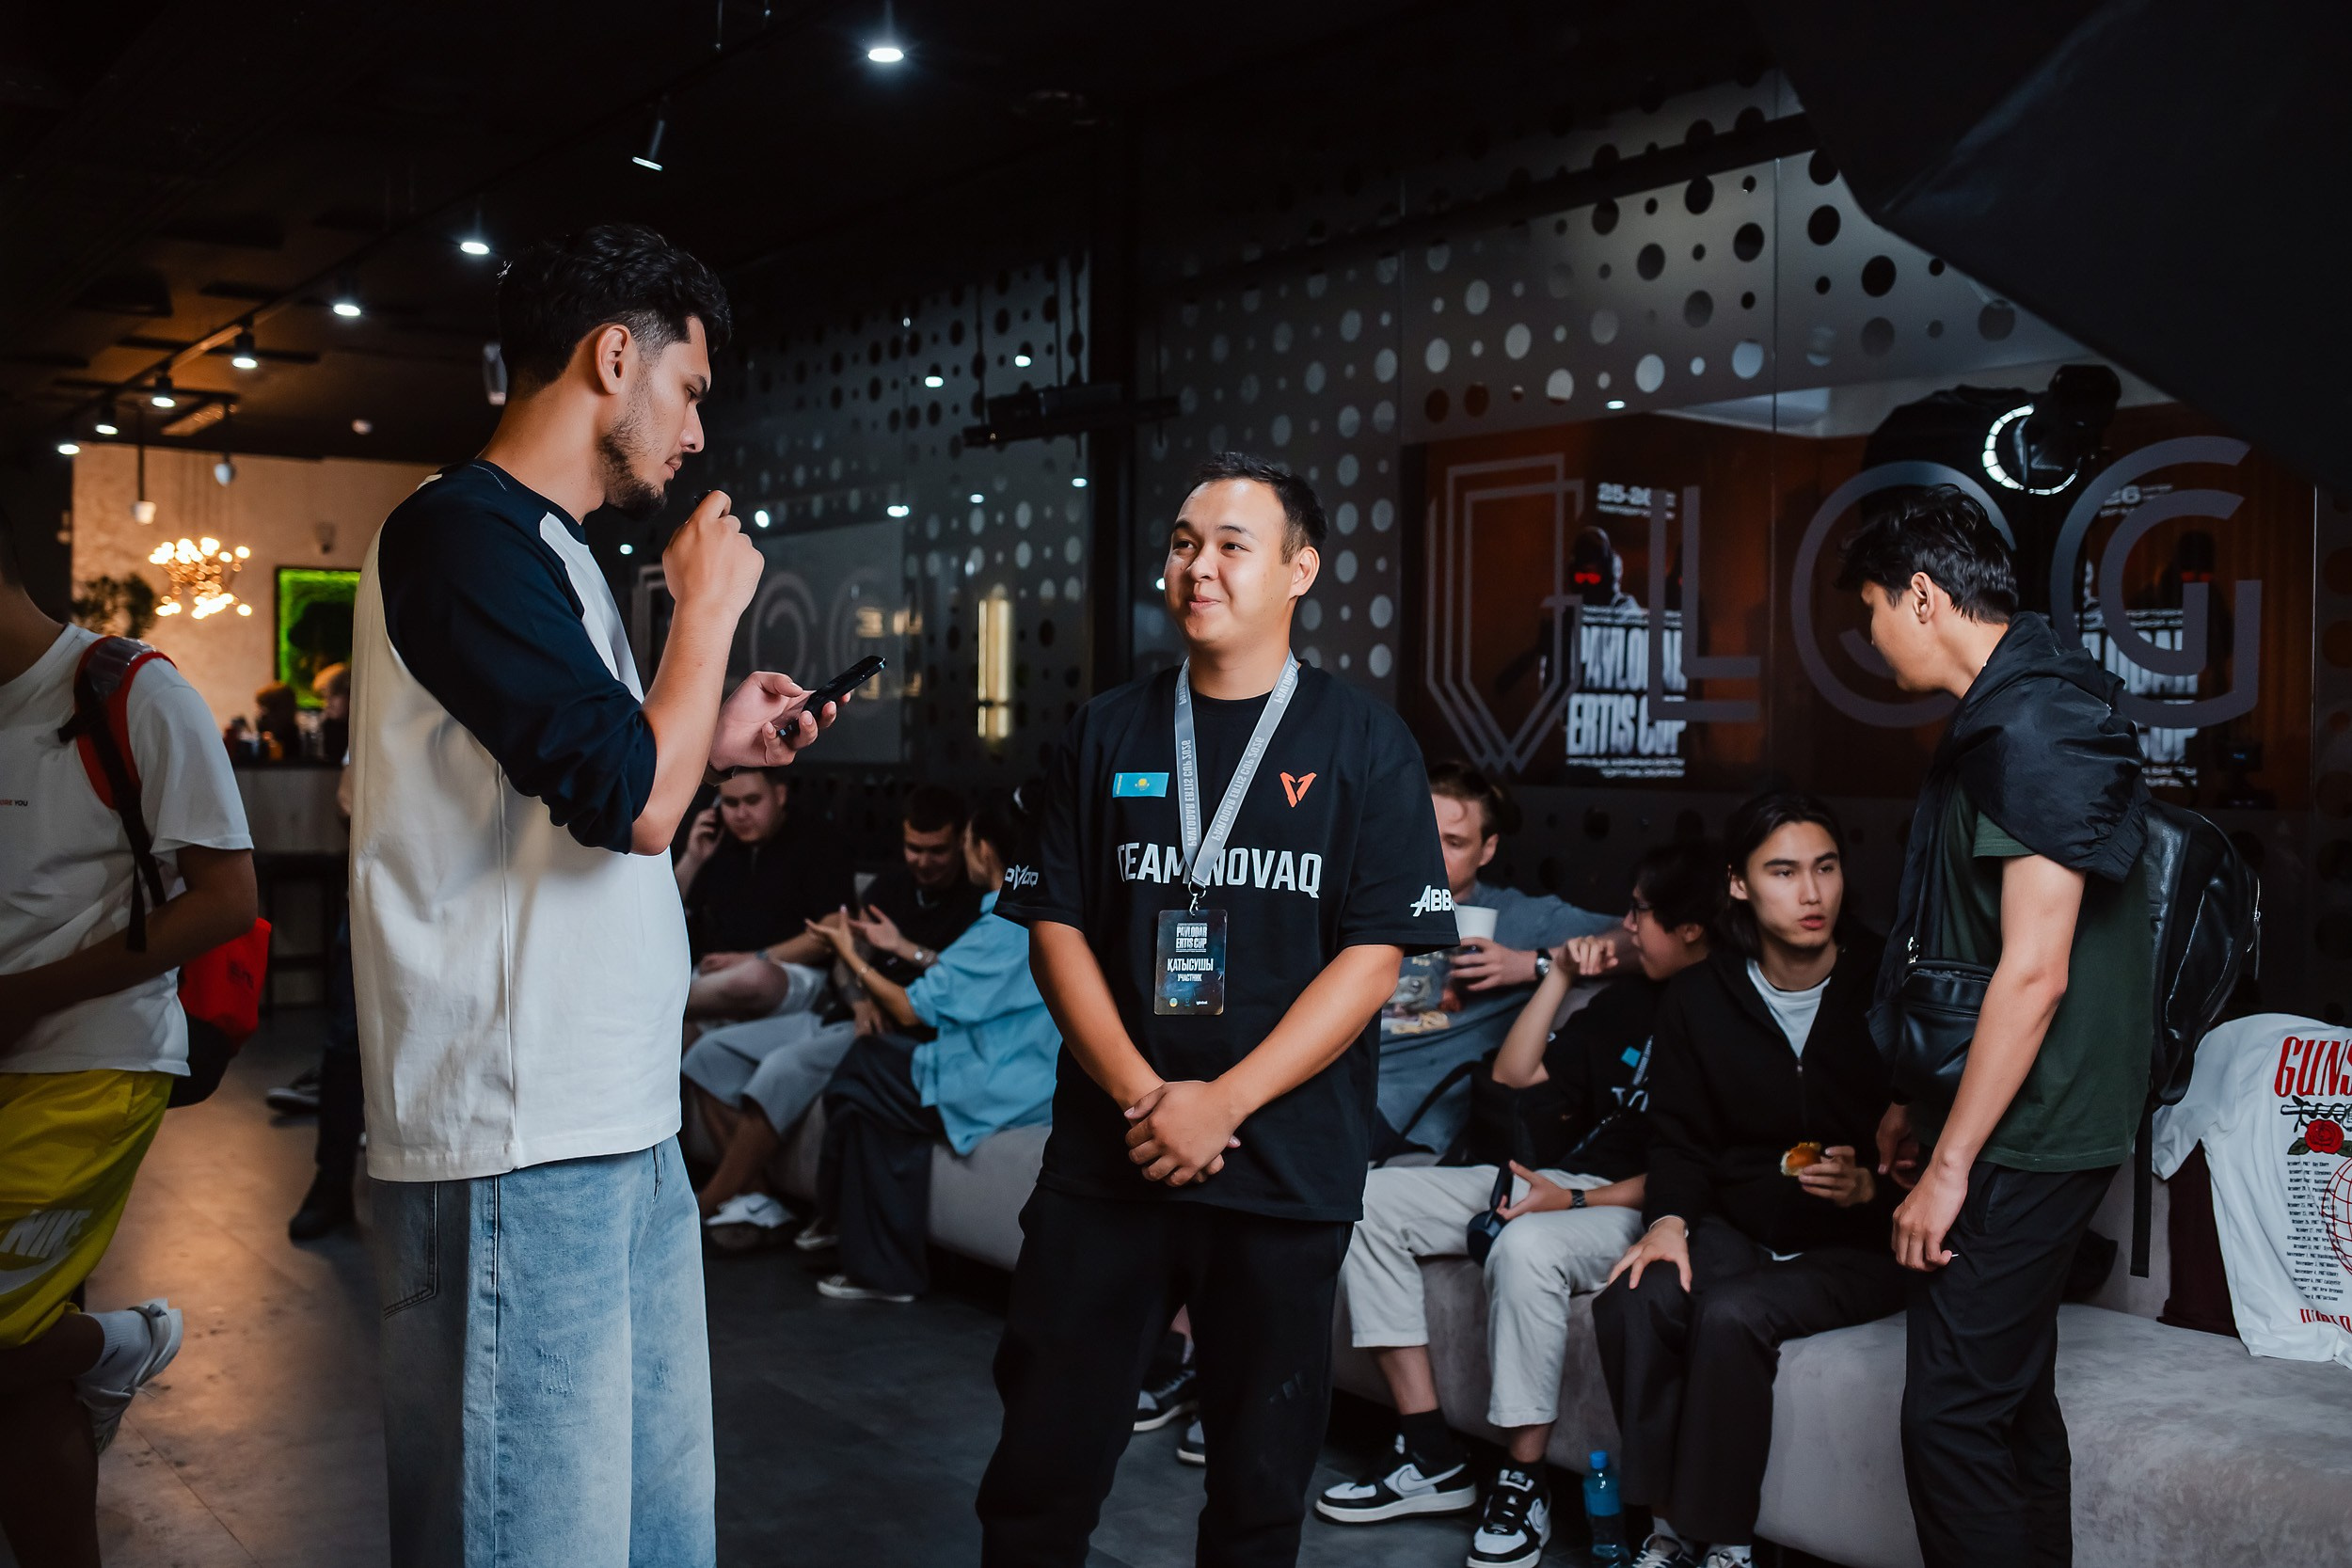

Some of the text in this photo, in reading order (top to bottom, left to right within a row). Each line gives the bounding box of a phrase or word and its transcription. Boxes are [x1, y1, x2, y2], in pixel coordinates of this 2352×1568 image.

[1565, 692, 1638, 756] ERTIS
[1410, 885, 1454, 917] ABB
[1176, 927, 1207, 937] PAVLODAR
[1176, 938, 1207, 949] ERTIS CUP
[1167, 958, 1213, 972] ҚАТЫСУШЫ
